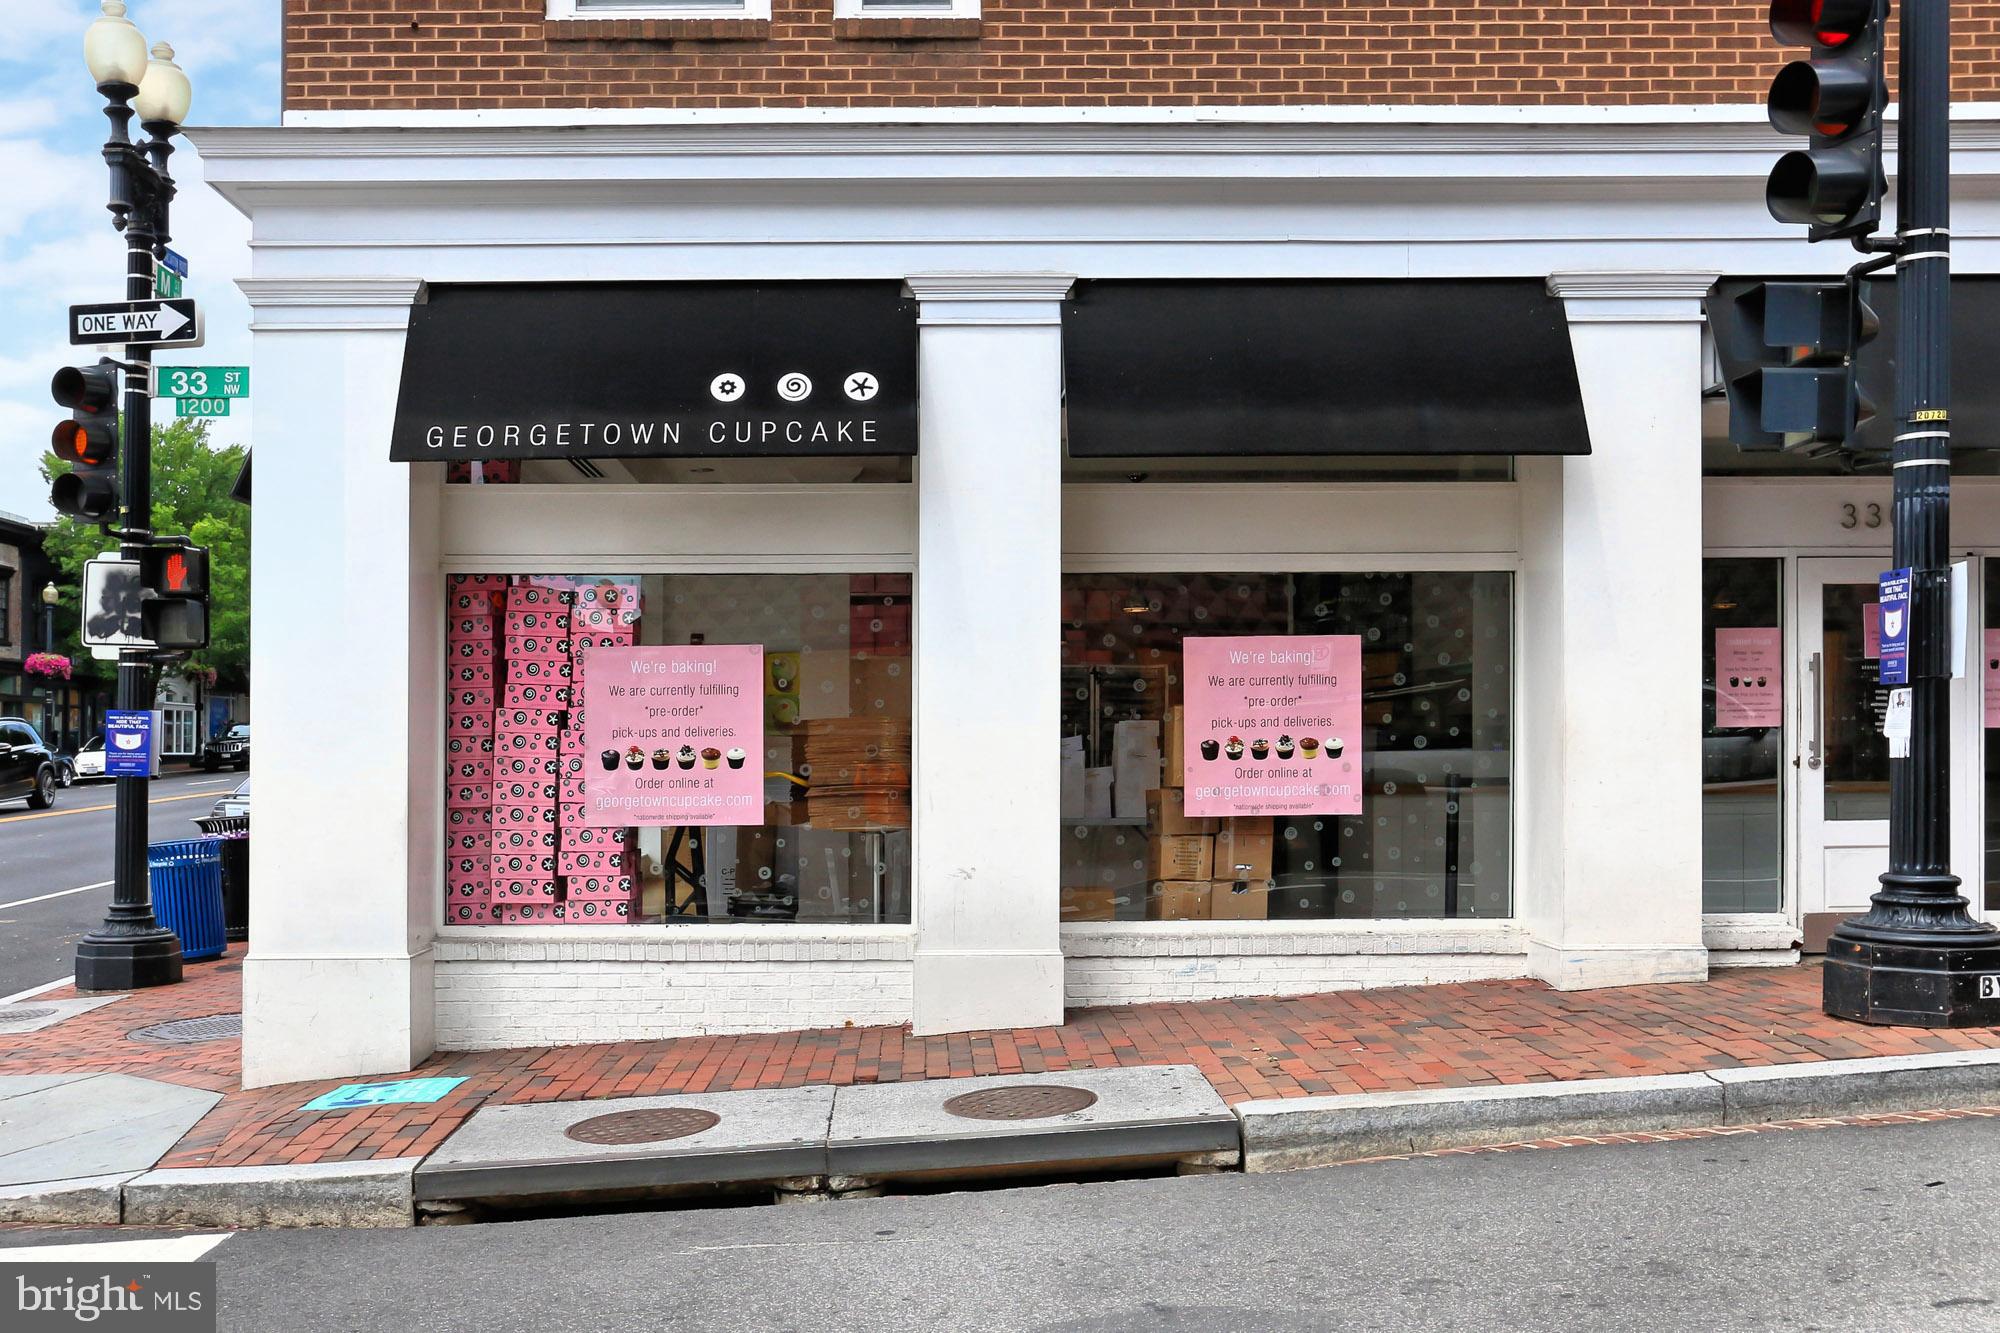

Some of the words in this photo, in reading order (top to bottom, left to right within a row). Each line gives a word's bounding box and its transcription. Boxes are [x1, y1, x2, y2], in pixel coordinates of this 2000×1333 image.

[160, 270, 171, 298] M
[82, 314, 116, 332] ONE
[122, 313, 158, 330] WAY
[171, 371, 208, 396] 33
[224, 372, 241, 383] ST
[223, 384, 241, 395] NW
[180, 398, 225, 415] 1200
[426, 421, 681, 448] GEORGETOWN
[709, 419, 877, 444] CUPCAKE
[1840, 502, 1894, 529] 33
[1229, 650, 1265, 664] We're
[1269, 649, 1315, 666] baking!
[630, 660, 667, 674] We're
[671, 659, 717, 676] baking!
[1207, 675, 1225, 687] We
[1228, 677, 1246, 687] are
[1248, 674, 1295, 688] currently
[1298, 673, 1338, 688] fulfilling
[608, 685, 626, 697] We
[629, 687, 646, 697] are
[649, 684, 696, 698] currently
[699, 683, 740, 698] fulfilling
[1211, 716, 1257, 730] pick-ups
[1260, 716, 1280, 728] and
[1283, 715, 1335, 727] deliveries.
[611, 726, 657, 740] pick-ups
[661, 726, 681, 738] and
[684, 726, 737, 738] deliveries.
[1234, 767, 1263, 779] Order
[1267, 767, 1299, 779] online
[1302, 767, 1313, 778] at
[634, 777, 665, 789] Order
[668, 777, 700, 789] online
[703, 777, 714, 789] at
[1195, 783, 1351, 801] georgetowncupcake.com
[595, 794, 753, 811] georgetowncupcake.com
[665, 813, 690, 821] shipping
